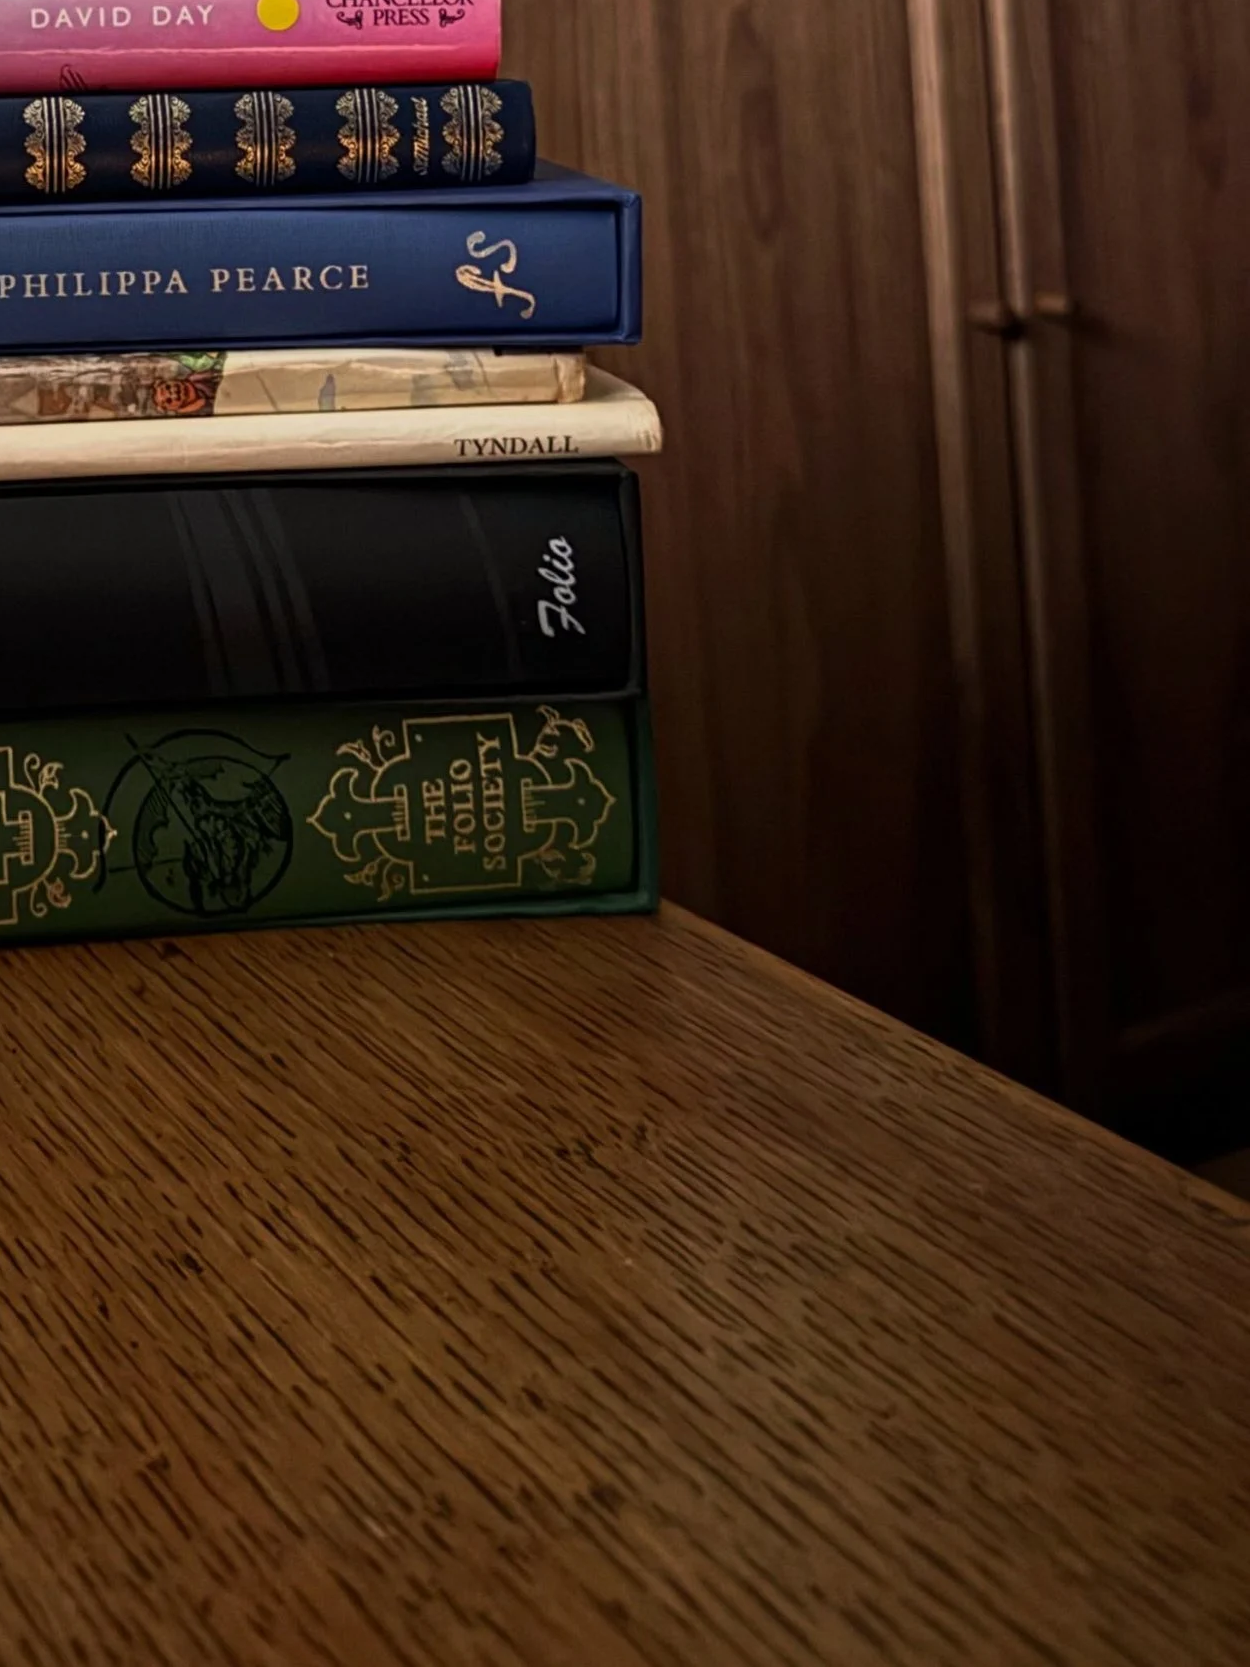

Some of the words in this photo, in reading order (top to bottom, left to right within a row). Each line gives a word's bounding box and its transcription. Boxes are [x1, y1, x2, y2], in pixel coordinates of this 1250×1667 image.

[30, 6, 133, 30] DAVID
[151, 4, 215, 28] DAY
[372, 8, 431, 27] PRESS
[209, 263, 372, 295] PEARCE
[453, 435, 581, 458] TYNDALL
[538, 534, 588, 639] Folio
[421, 777, 448, 846] THE
[448, 757, 477, 856] FOLIO
[475, 730, 508, 871] SOCIETY
